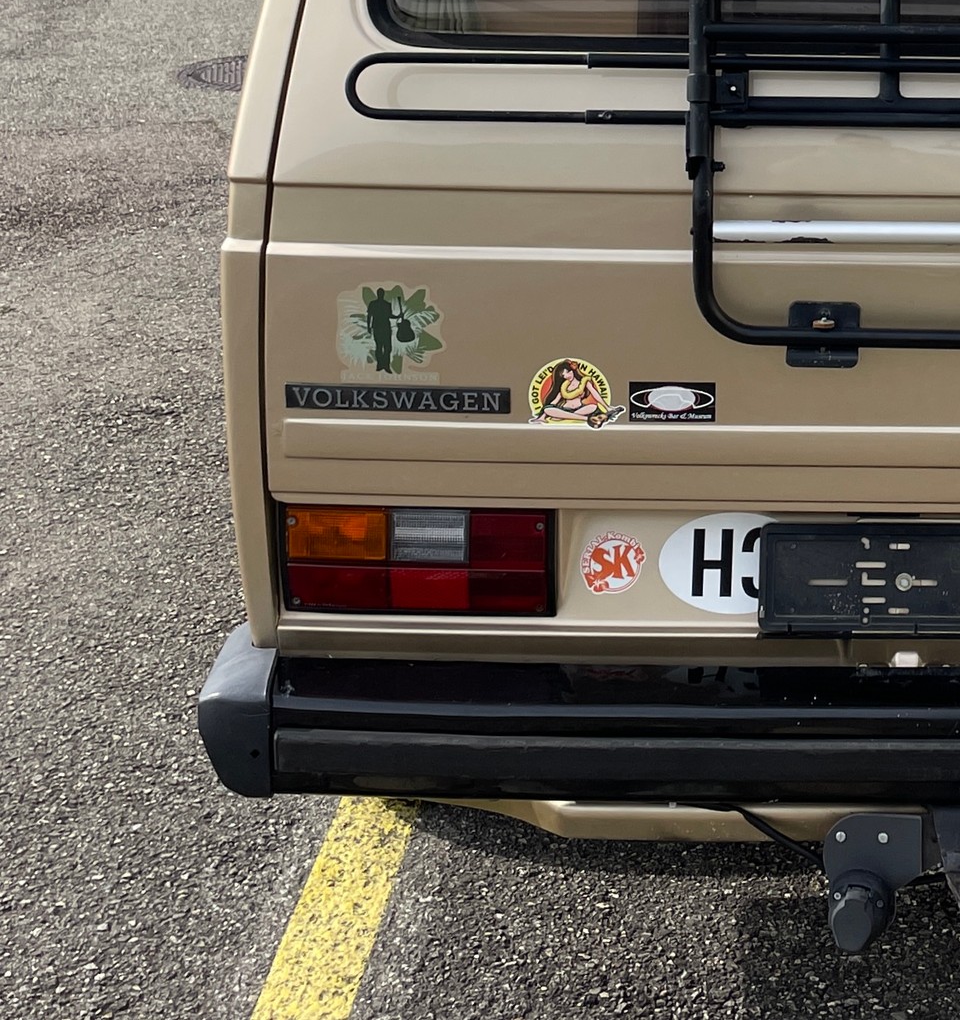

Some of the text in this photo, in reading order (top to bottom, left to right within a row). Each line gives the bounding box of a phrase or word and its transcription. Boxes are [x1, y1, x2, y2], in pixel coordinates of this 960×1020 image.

[292, 386, 501, 412] VOLKSWAGEN
[531, 385, 539, 404] GOT
[590, 544, 636, 580] SK
